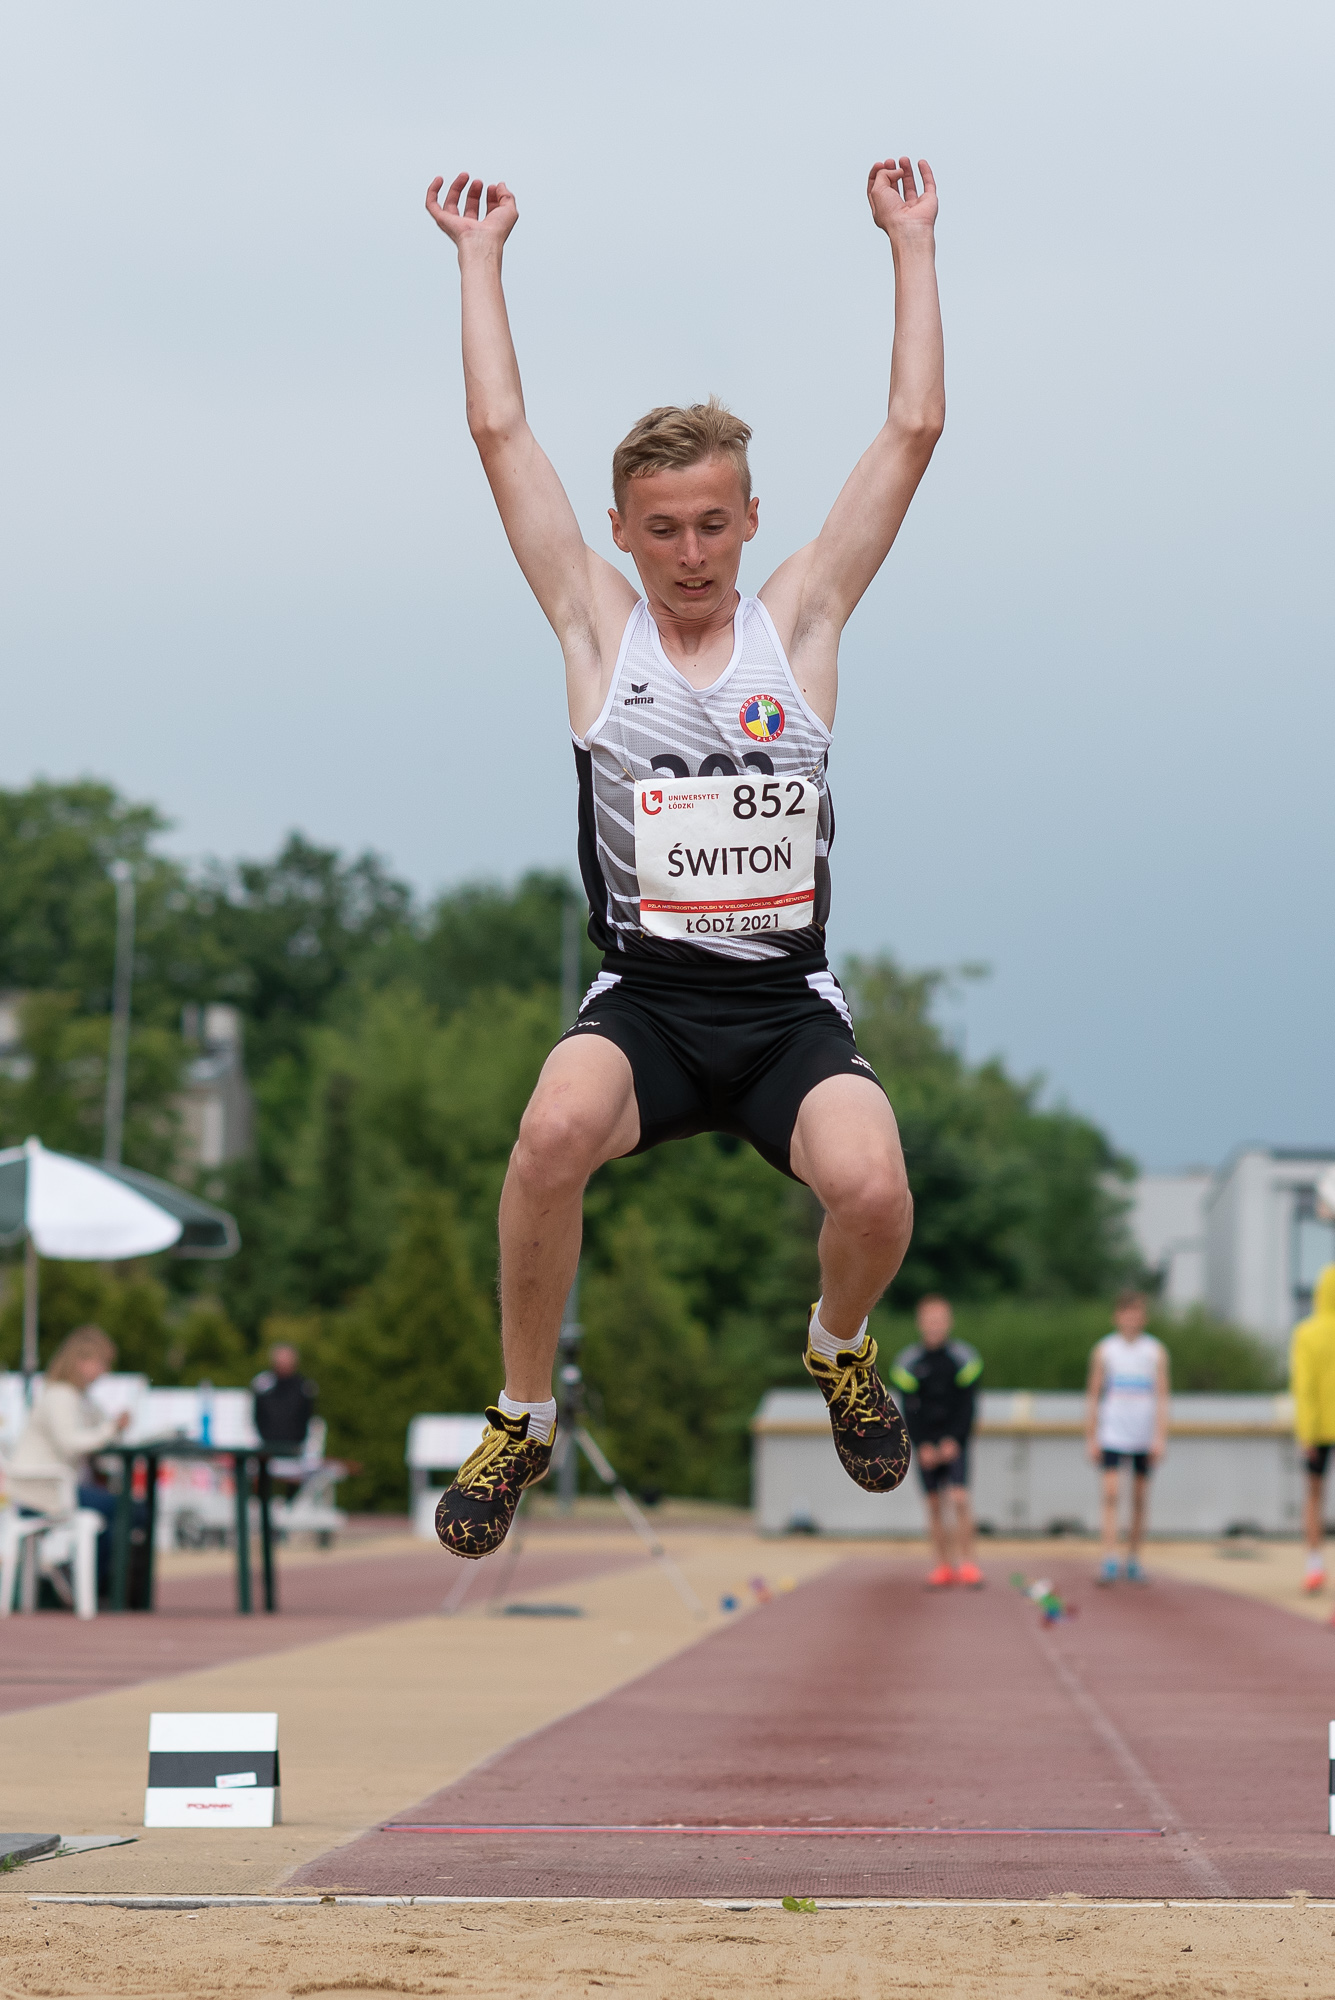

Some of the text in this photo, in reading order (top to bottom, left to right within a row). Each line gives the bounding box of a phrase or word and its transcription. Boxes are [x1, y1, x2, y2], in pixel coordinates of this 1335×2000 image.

[624, 695, 654, 706] erima
[668, 793, 720, 801] UNIWERSYTET
[732, 781, 806, 820] 852
[668, 802, 695, 810] ŁÓDZKI
[667, 836, 792, 878] ŚWITOŃ
[685, 913, 779, 934] ŁÓDŹ 2021
